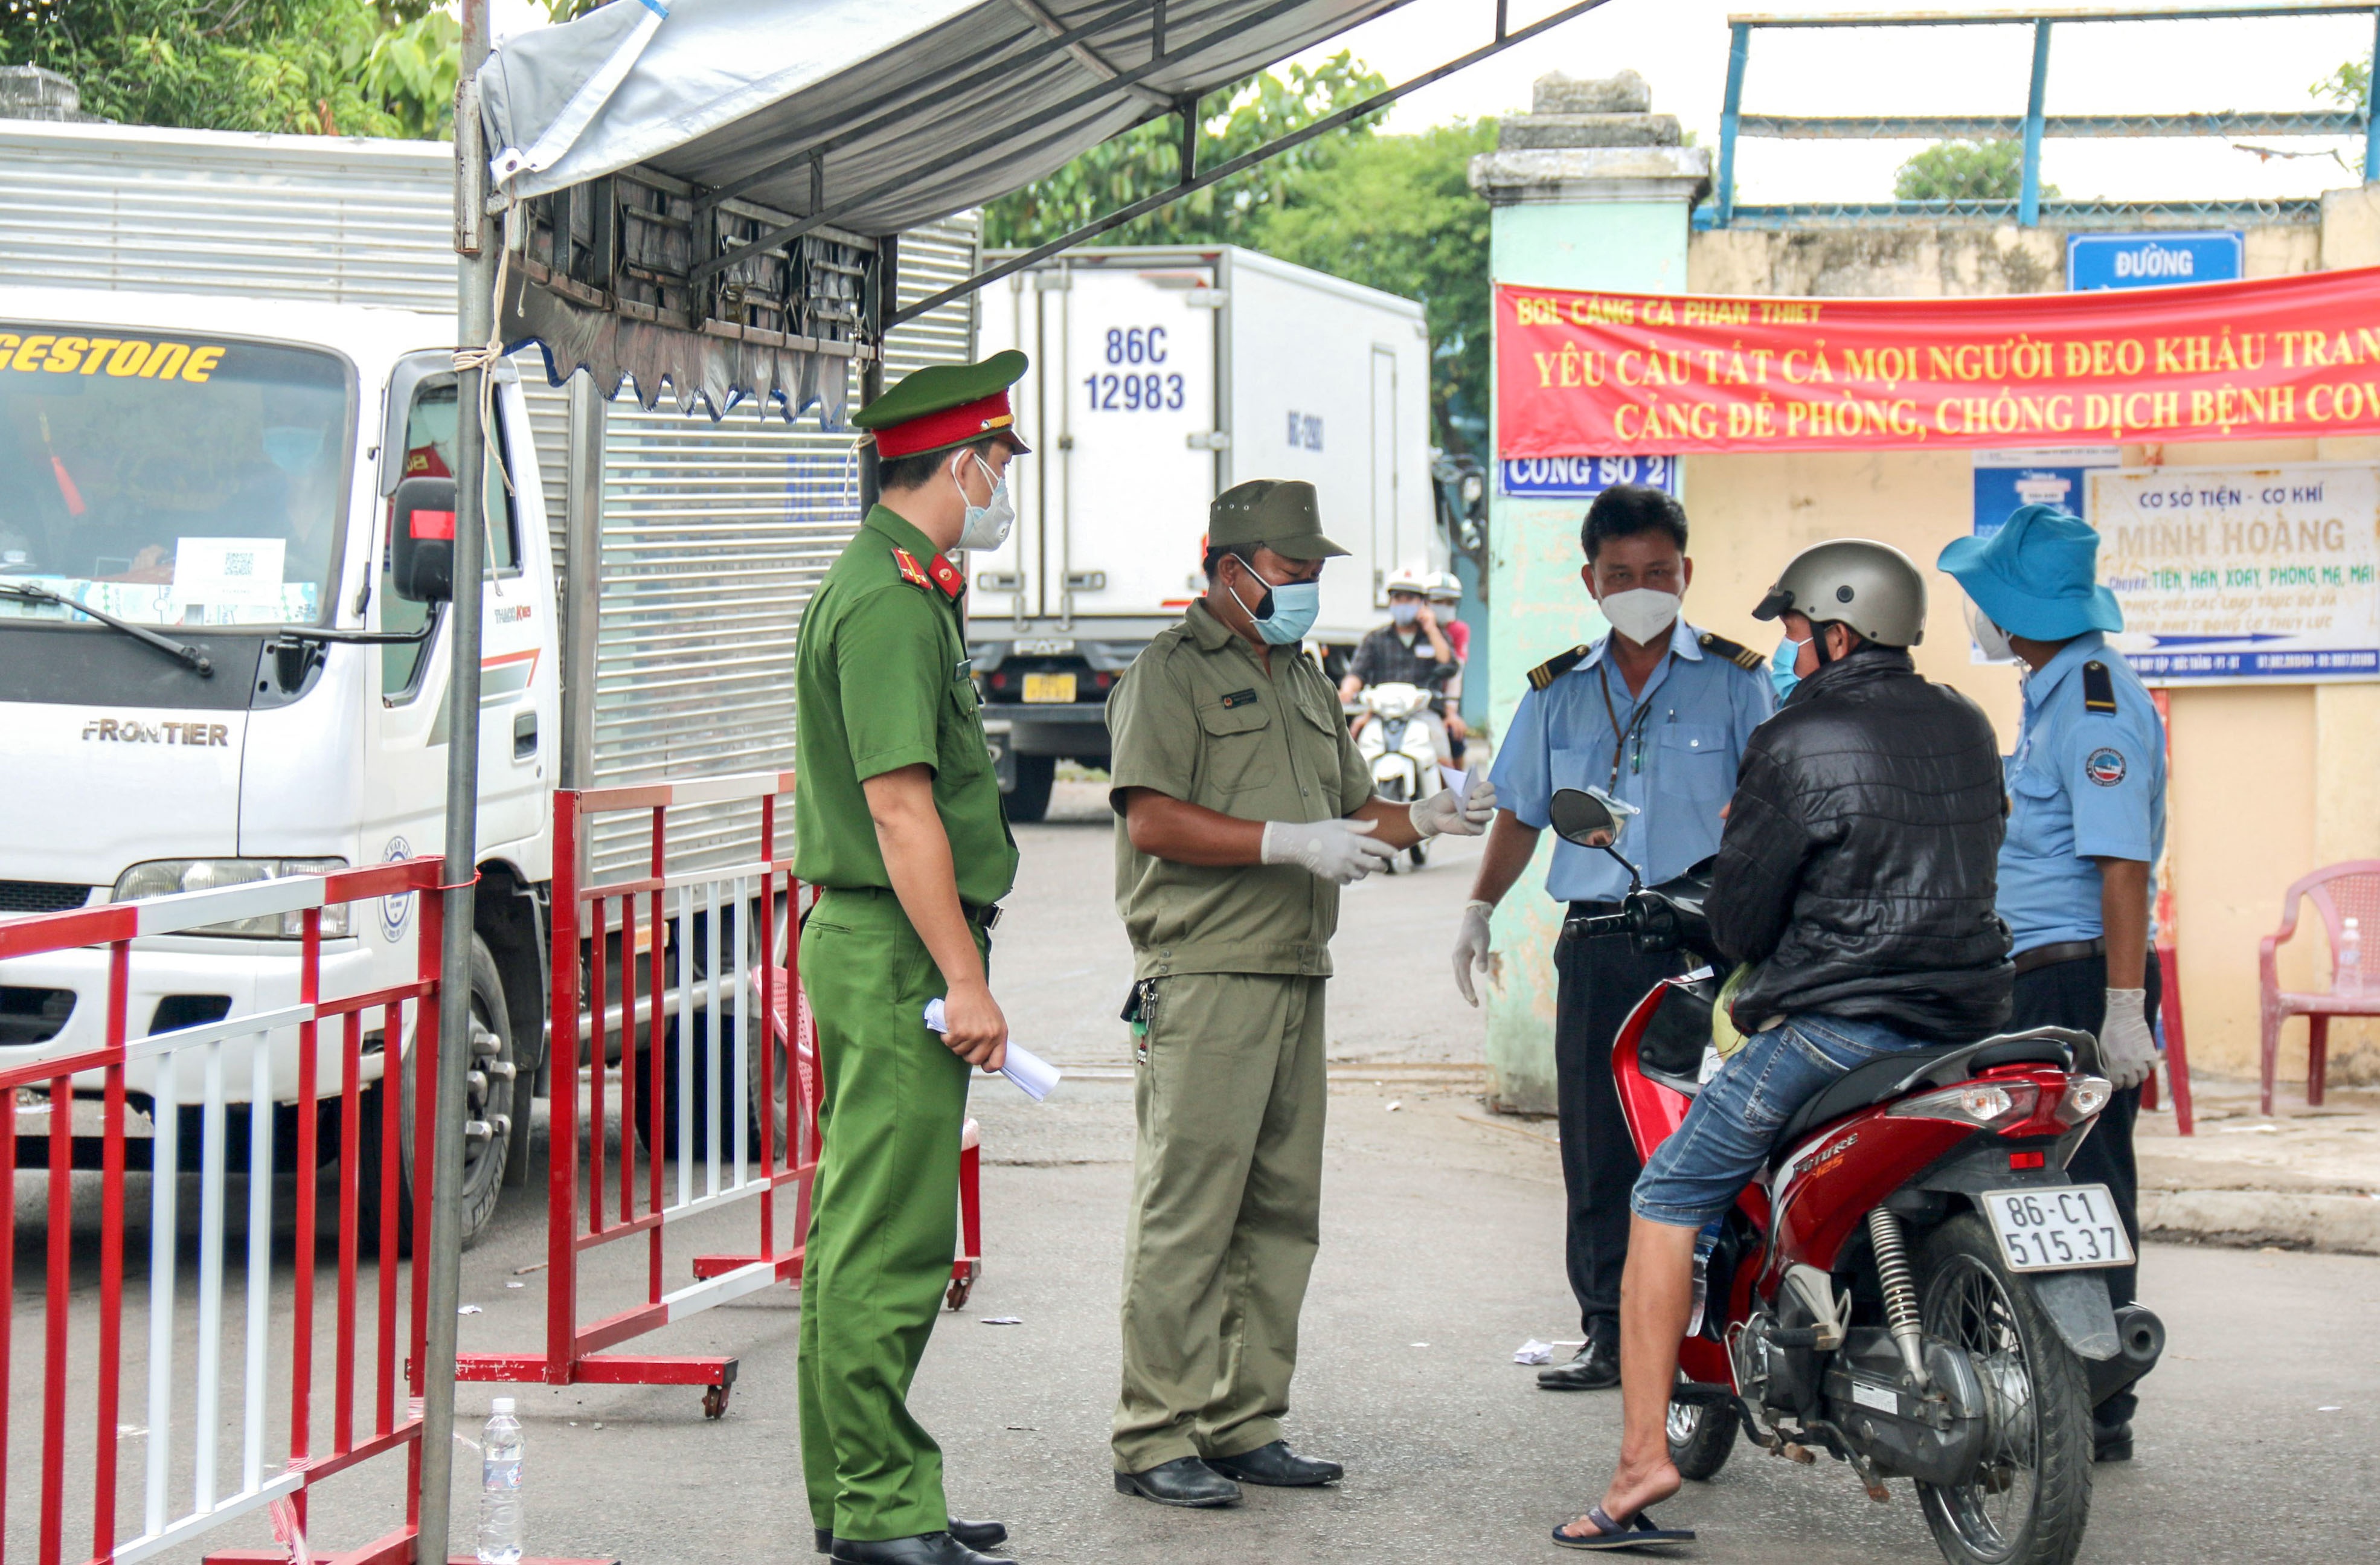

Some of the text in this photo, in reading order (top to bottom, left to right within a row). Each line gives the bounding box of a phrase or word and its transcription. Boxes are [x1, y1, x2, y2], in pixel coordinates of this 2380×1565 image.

[2115, 242, 2194, 277] ĐƯỜNG
[1106, 326, 1167, 364] 86C
[1533, 341, 1607, 388] YÊU
[1782, 338, 1835, 385] CẢ
[1843, 347, 1919, 391] MỌI
[1928, 333, 2055, 381] NGƯỜI
[2064, 338, 2145, 378] ĐEO
[1083, 373, 1184, 410] 12983
[1614, 393, 1718, 442] CẢNG
[1786, 390, 1927, 442] PHÒNG,
[1936, 385, 2073, 434] CHỐNG
[2084, 391, 2180, 439] DỊCH
[2191, 382, 2296, 435] BỆNH
[1646, 455, 1666, 484] 2
[2140, 492, 2163, 508] CƠ
[2262, 488, 2286, 505] CƠ
[2292, 481, 2324, 503] KHÍ
[2116, 522, 2208, 559] MINH
[82, 718, 229, 747] FRONTIER
[2006, 1193, 2096, 1227] 86-C1
[2005, 1227, 2116, 1264] 515.37
